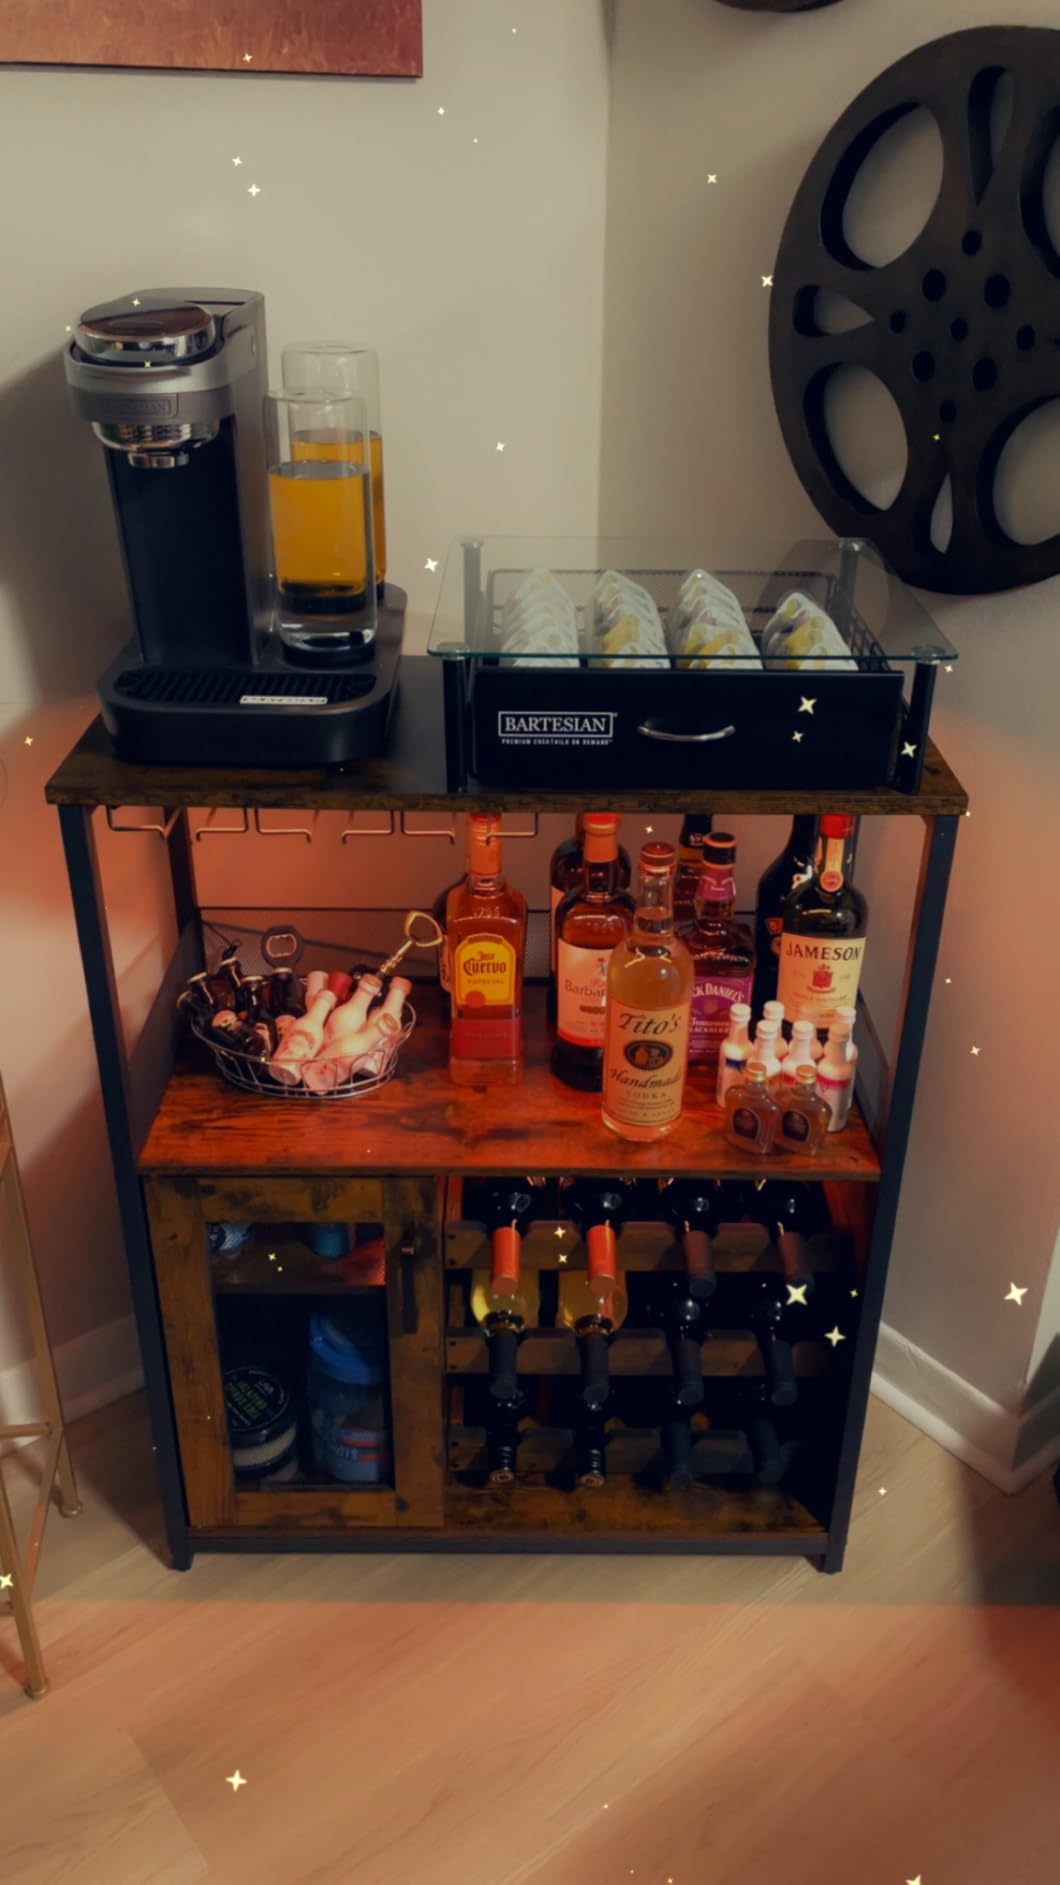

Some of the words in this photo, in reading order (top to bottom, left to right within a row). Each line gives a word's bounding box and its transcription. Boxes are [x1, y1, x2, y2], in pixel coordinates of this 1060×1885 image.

[504, 717, 607, 732] BARTESIAN
[785, 942, 863, 961] JAMESON
[463, 957, 507, 976] Cuervo
[618, 1012, 681, 1035] Tito's
